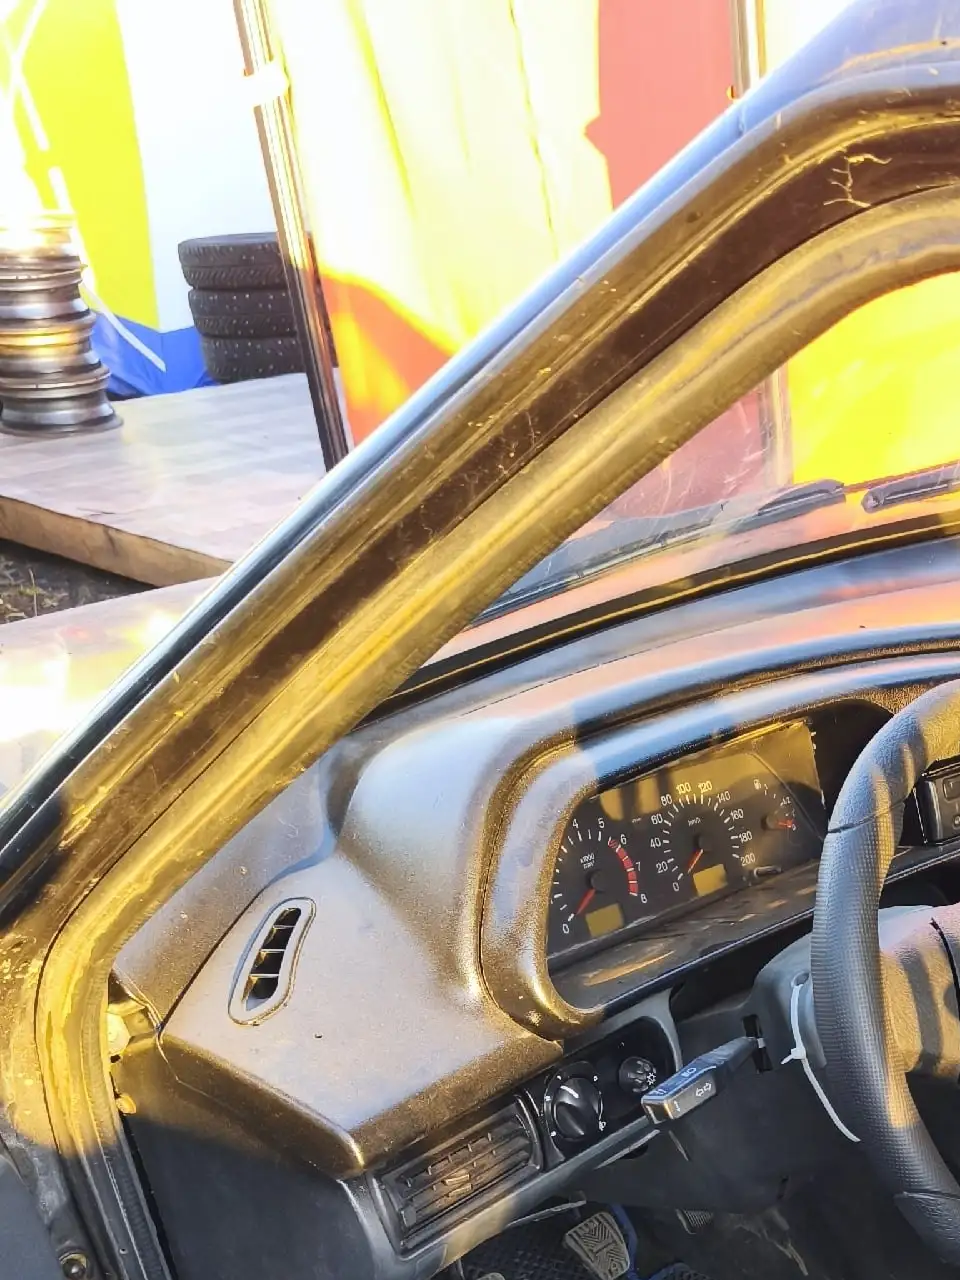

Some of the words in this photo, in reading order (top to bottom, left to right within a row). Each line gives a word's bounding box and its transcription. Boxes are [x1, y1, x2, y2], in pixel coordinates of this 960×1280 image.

[676, 782, 692, 795] 100
[698, 780, 713, 794] 120
[660, 794, 673, 806] 80
[716, 790, 731, 804] 140
[650, 813, 663, 825] 60
[730, 808, 744, 821] 160
[572, 818, 579, 829] 4
[598, 817, 605, 829] 5
[620, 834, 627, 845] 6
[650, 837, 662, 849] 40
[739, 831, 753, 843] 180
[740, 853, 756, 866] 200
[635, 861, 641, 871] 7
[655, 861, 668, 874] 20
[672, 881, 680, 892] 0
[640, 893, 648, 904] 8
[562, 923, 570, 934] 0
